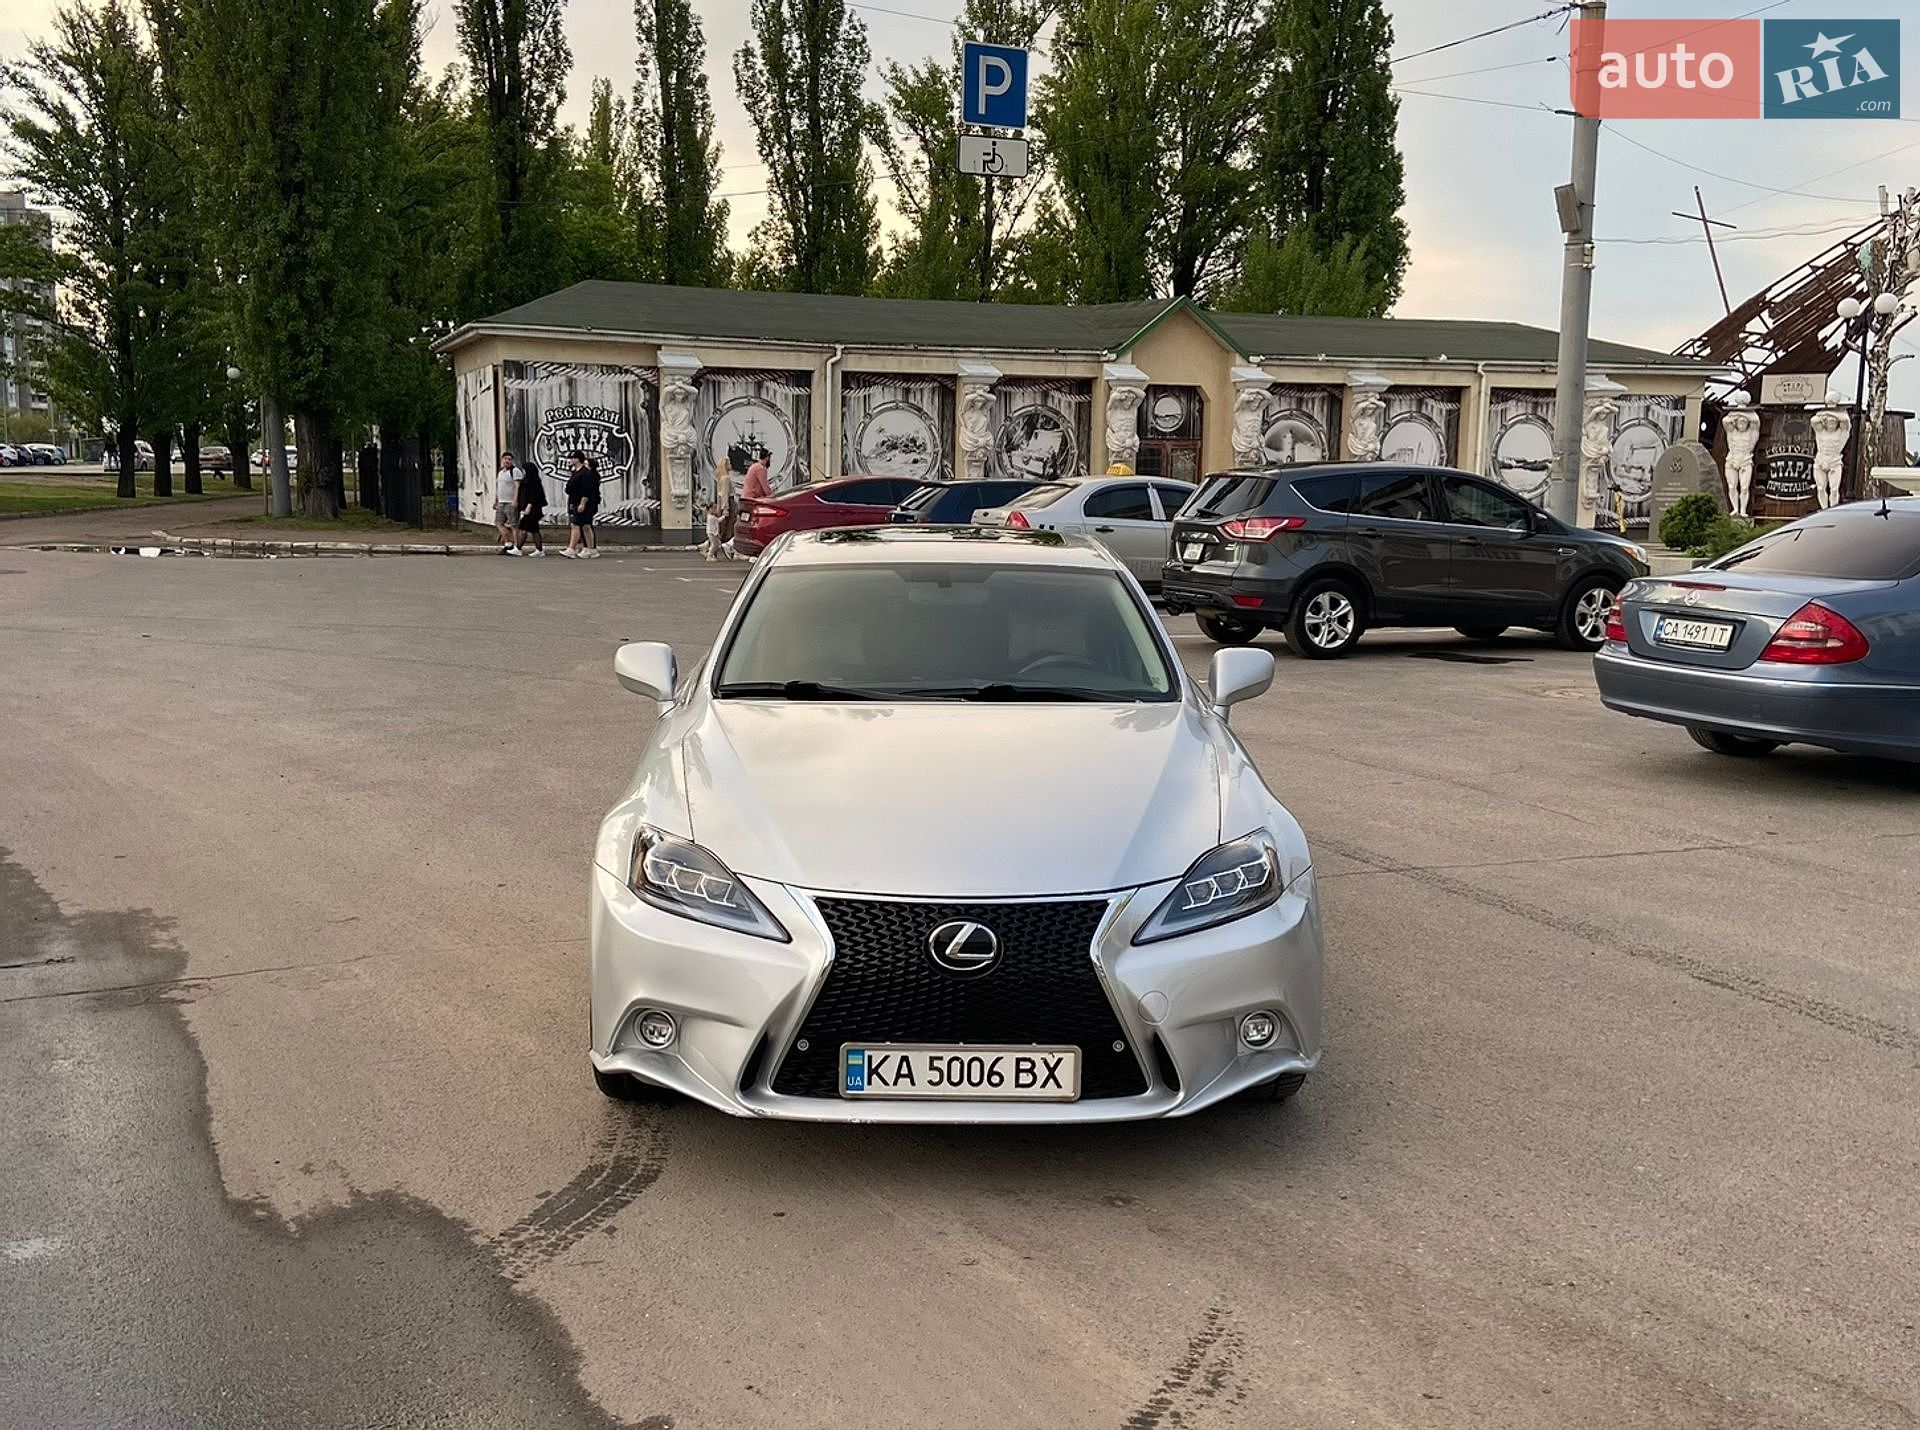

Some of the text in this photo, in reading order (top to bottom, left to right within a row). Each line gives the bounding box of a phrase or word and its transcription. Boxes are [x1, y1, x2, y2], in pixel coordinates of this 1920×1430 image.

[978, 55, 1012, 114] P
[545, 405, 619, 424] РЕСТОРАН
[556, 428, 608, 454] СТАРА
[1770, 461, 1812, 480] СТАРА
[1663, 622, 1679, 637] CA
[1682, 624, 1708, 641] 1491
[847, 1054, 1064, 1089] UA KA 5006 BX
